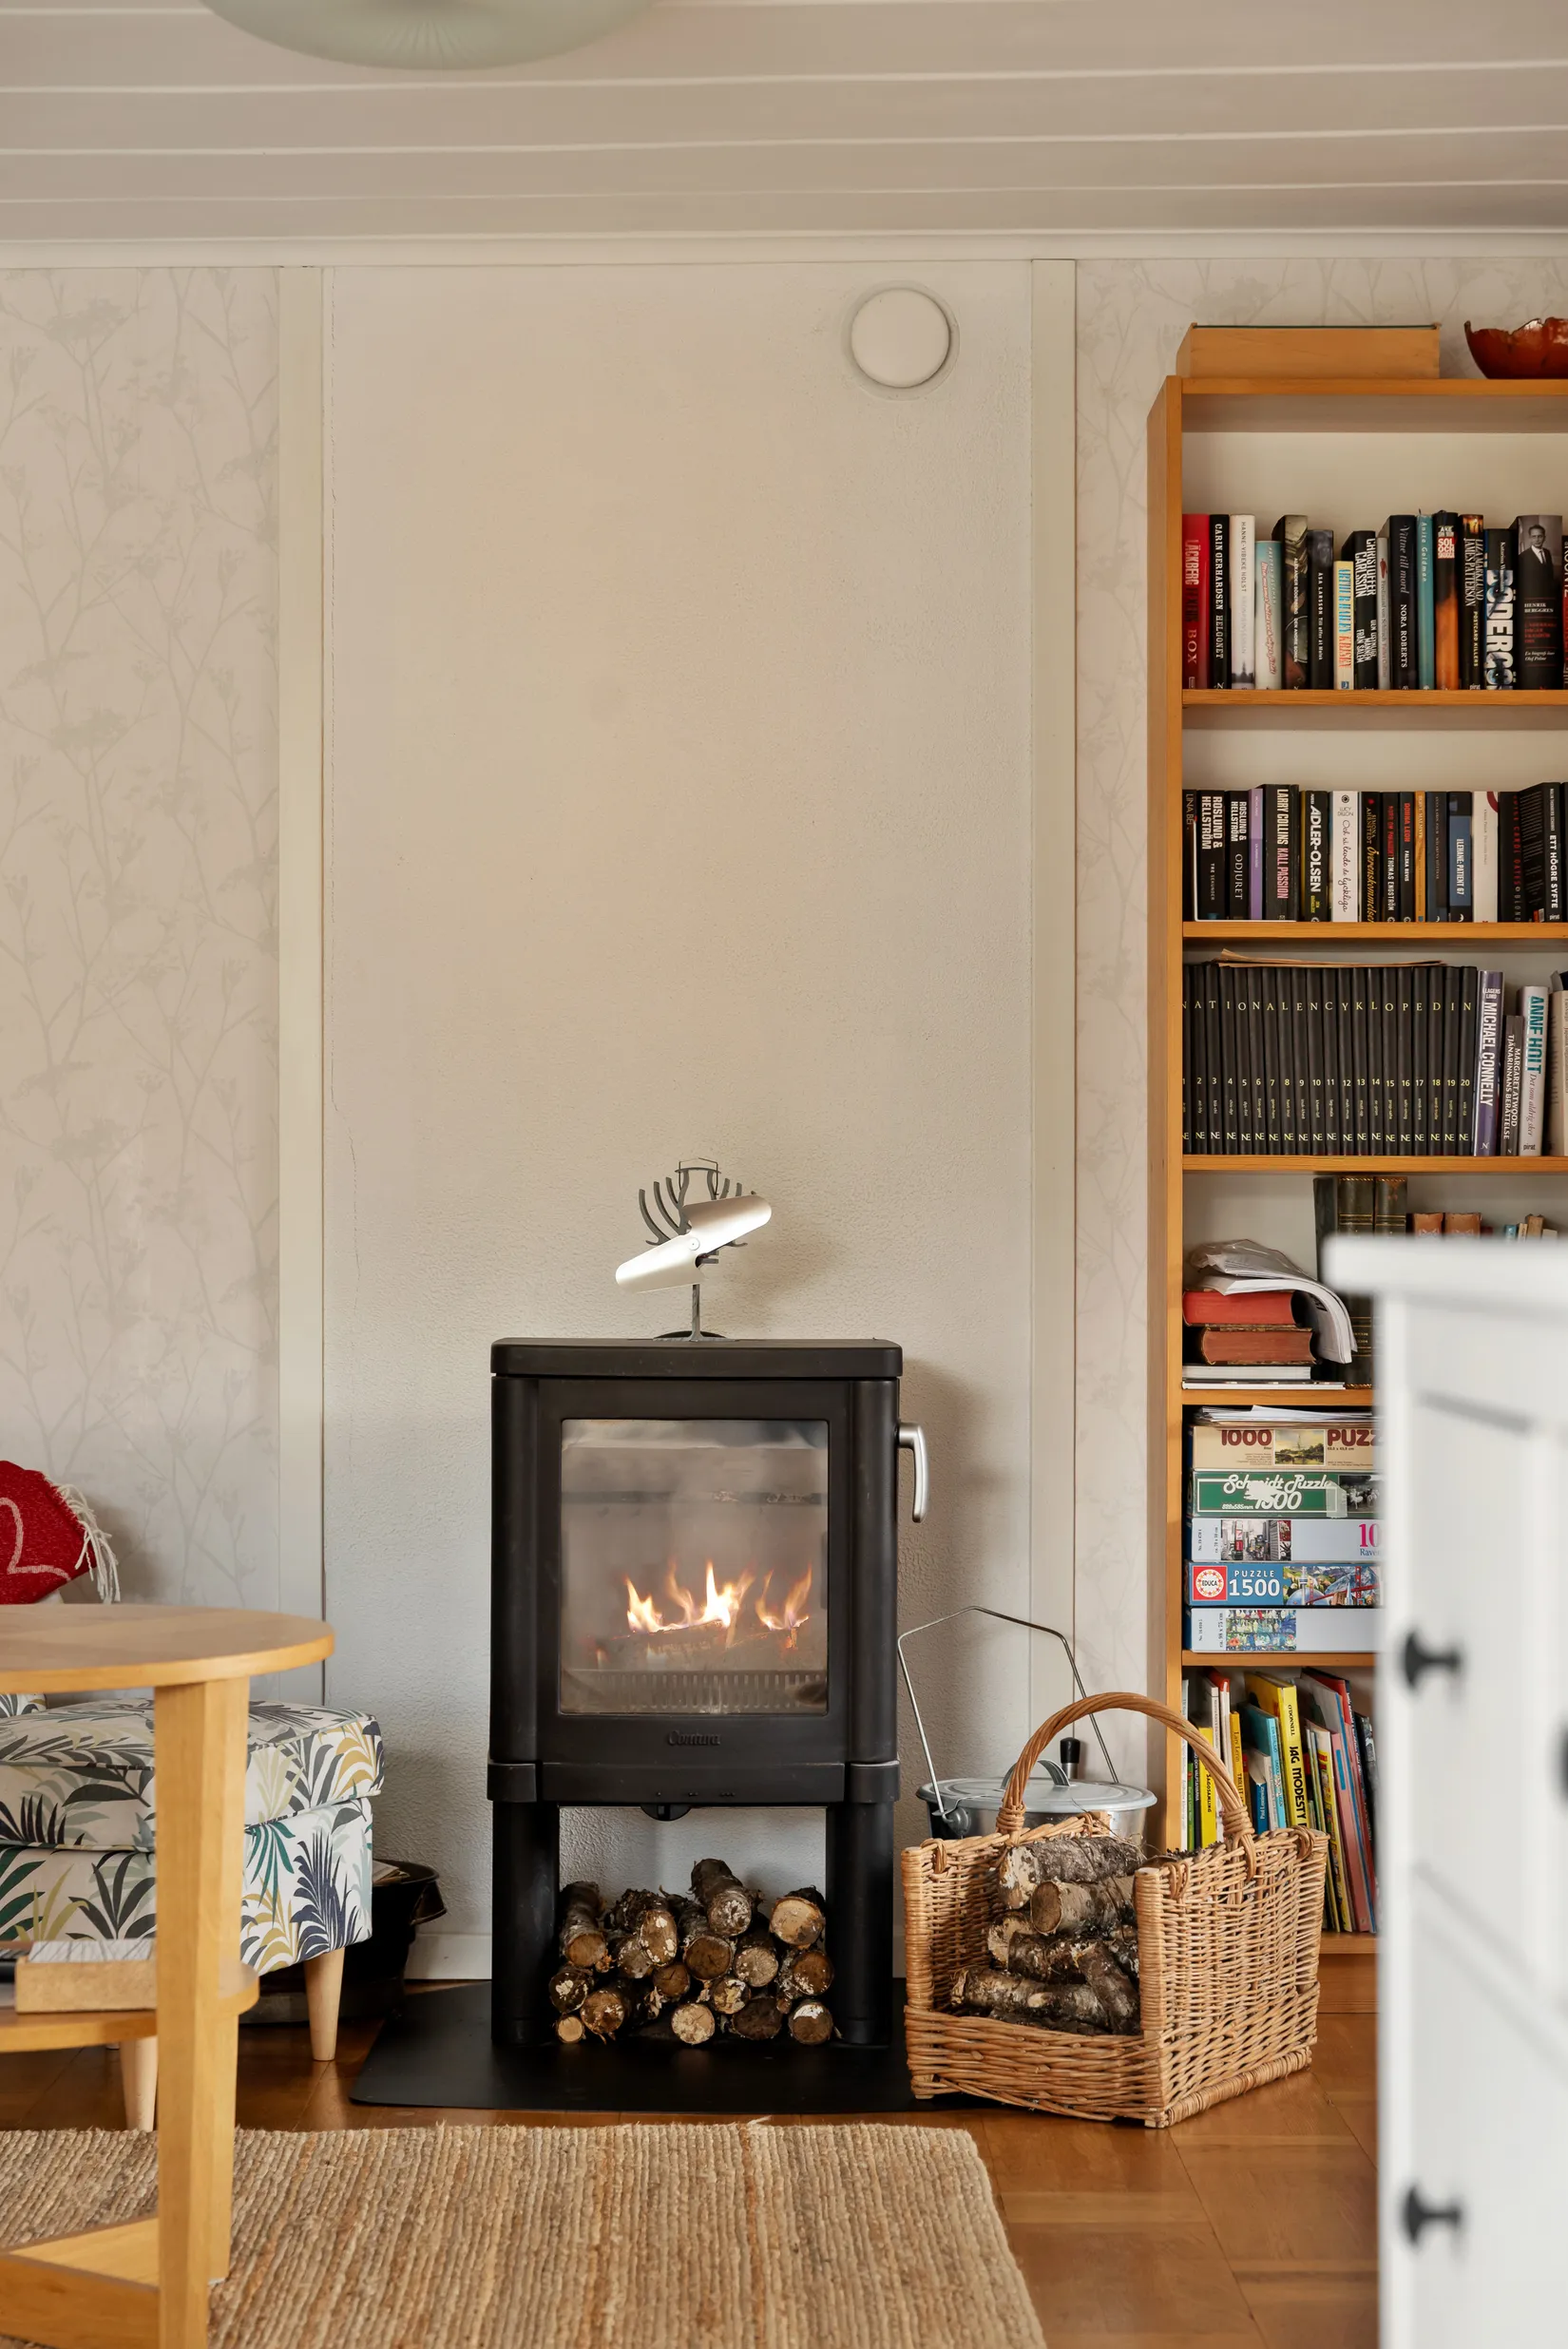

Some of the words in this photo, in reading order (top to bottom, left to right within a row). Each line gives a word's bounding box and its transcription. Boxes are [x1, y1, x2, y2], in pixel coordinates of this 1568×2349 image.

[1400, 525, 1410, 553] Vittne
[1463, 538, 1475, 561] JAMES
[1355, 551, 1367, 598] CARLSSON
[1367, 538, 1376, 596] CHRISTOFFER
[1400, 555, 1408, 568] till
[1339, 568, 1351, 602] ARTHUR
[1400, 570, 1409, 593] mord
[1464, 562, 1475, 607] PATTERSON
[1339, 603, 1351, 633] HAILEY
[1188, 629, 1196, 664] BOX
[1213, 796, 1222, 838] ROSLUND
[1277, 790, 1288, 812] LARRY
[1202, 796, 1213, 850] HELLSTRÖM
[1231, 801, 1239, 841] HELLSTRÖM
[1277, 813, 1288, 845] COLLINS
[1277, 848, 1288, 865] KALL
[1310, 805, 1321, 892] ADLER-OLSEN
[1342, 847, 1350, 867] levde
[1233, 854, 1243, 900] ODJURET
[1277, 867, 1288, 898] PASSION
[1550, 852, 1558, 881] HÖGRE
[1338, 878, 1351, 911] lyckliga
[1482, 1002, 1498, 1050] MICHAEL
[1530, 996, 1544, 1035] ANNE
[1505, 1035, 1516, 1092] TJÄNARINNANS
[1512, 1048, 1520, 1090] MARGARET
[1527, 1038, 1542, 1074] HOLT
[1480, 1052, 1495, 1106] CONNELLY
[1503, 1094, 1513, 1139] BERÄTTELSE
[1511, 1091, 1520, 1127] ATWOOD
[1526, 1101, 1536, 1122] aldrig
[1221, 1429, 1272, 1446] 1000
[1223, 1474, 1284, 1494] Schidt
[1230, 1579, 1280, 1596] 1500
[1290, 1747, 1300, 1764] JAG
[1292, 1768, 1307, 1819] MODESTY
